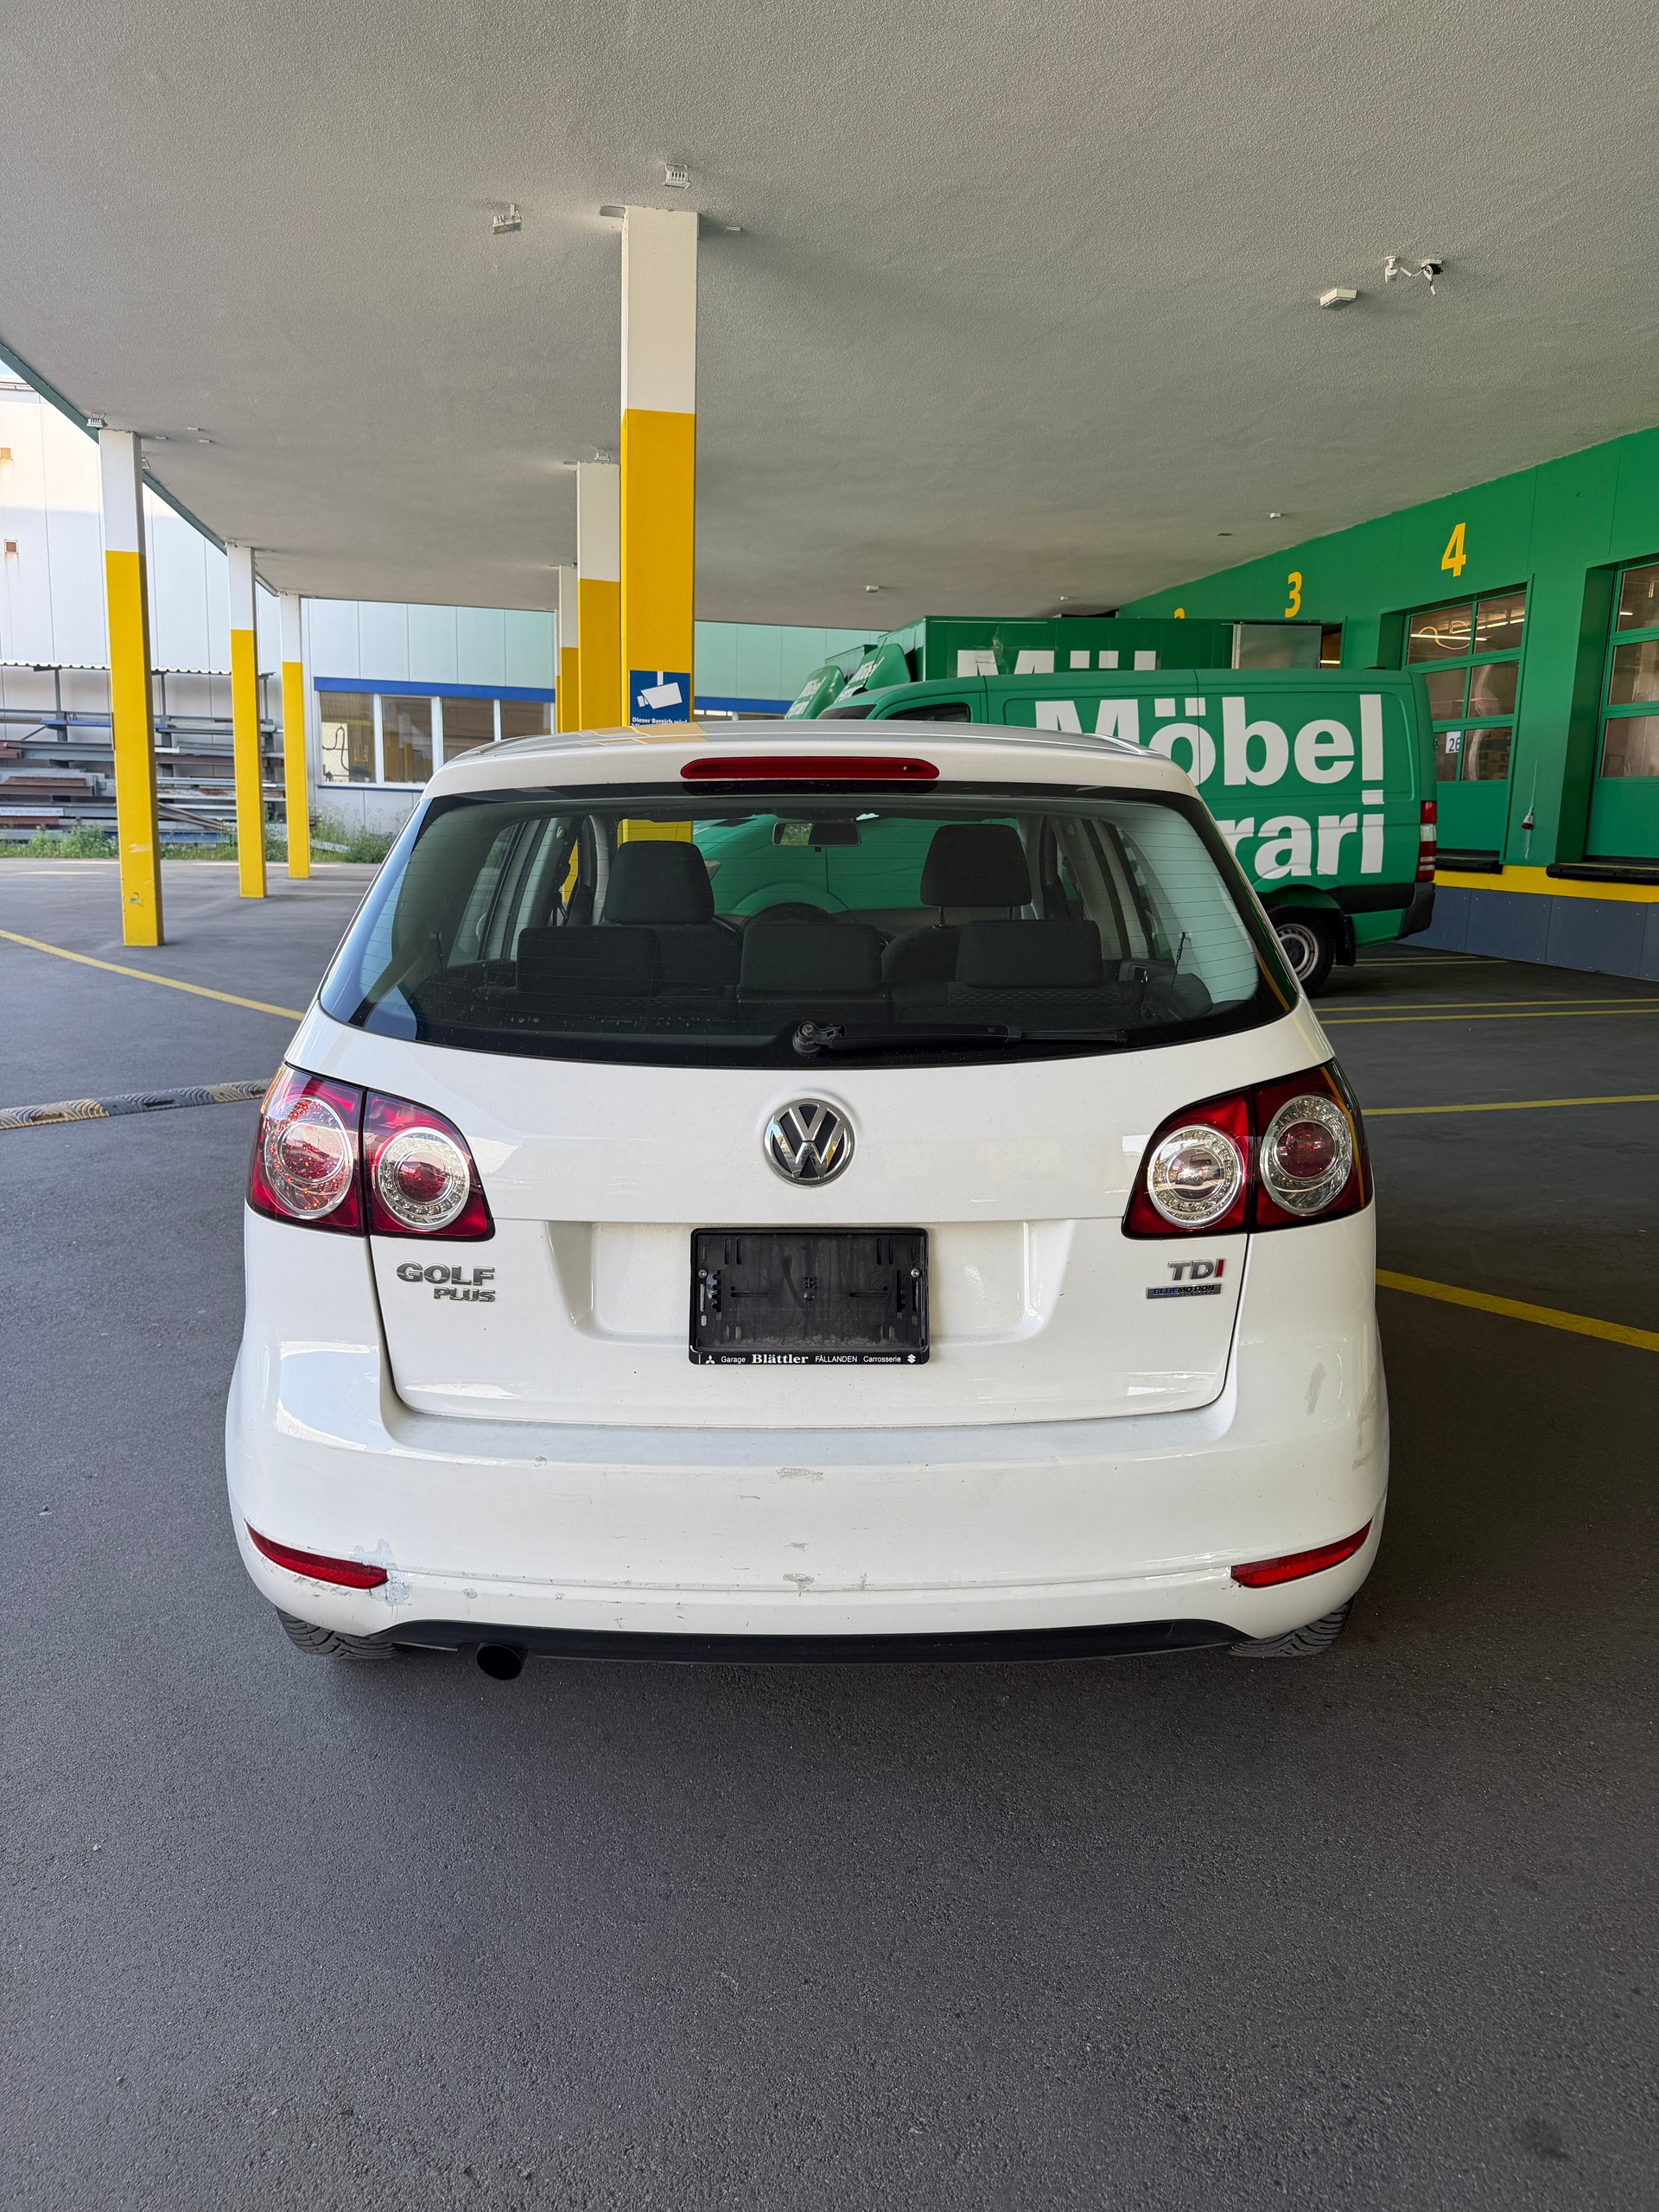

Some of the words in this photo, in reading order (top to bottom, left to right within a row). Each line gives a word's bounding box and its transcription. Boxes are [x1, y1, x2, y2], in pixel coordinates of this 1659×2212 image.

[1441, 523, 1467, 577] 4
[1285, 572, 1302, 618] 3
[397, 1262, 495, 1286] GOLF
[1167, 1258, 1225, 1281] TDI
[434, 1287, 495, 1302] PLUS
[752, 1354, 809, 1363] Blättler
